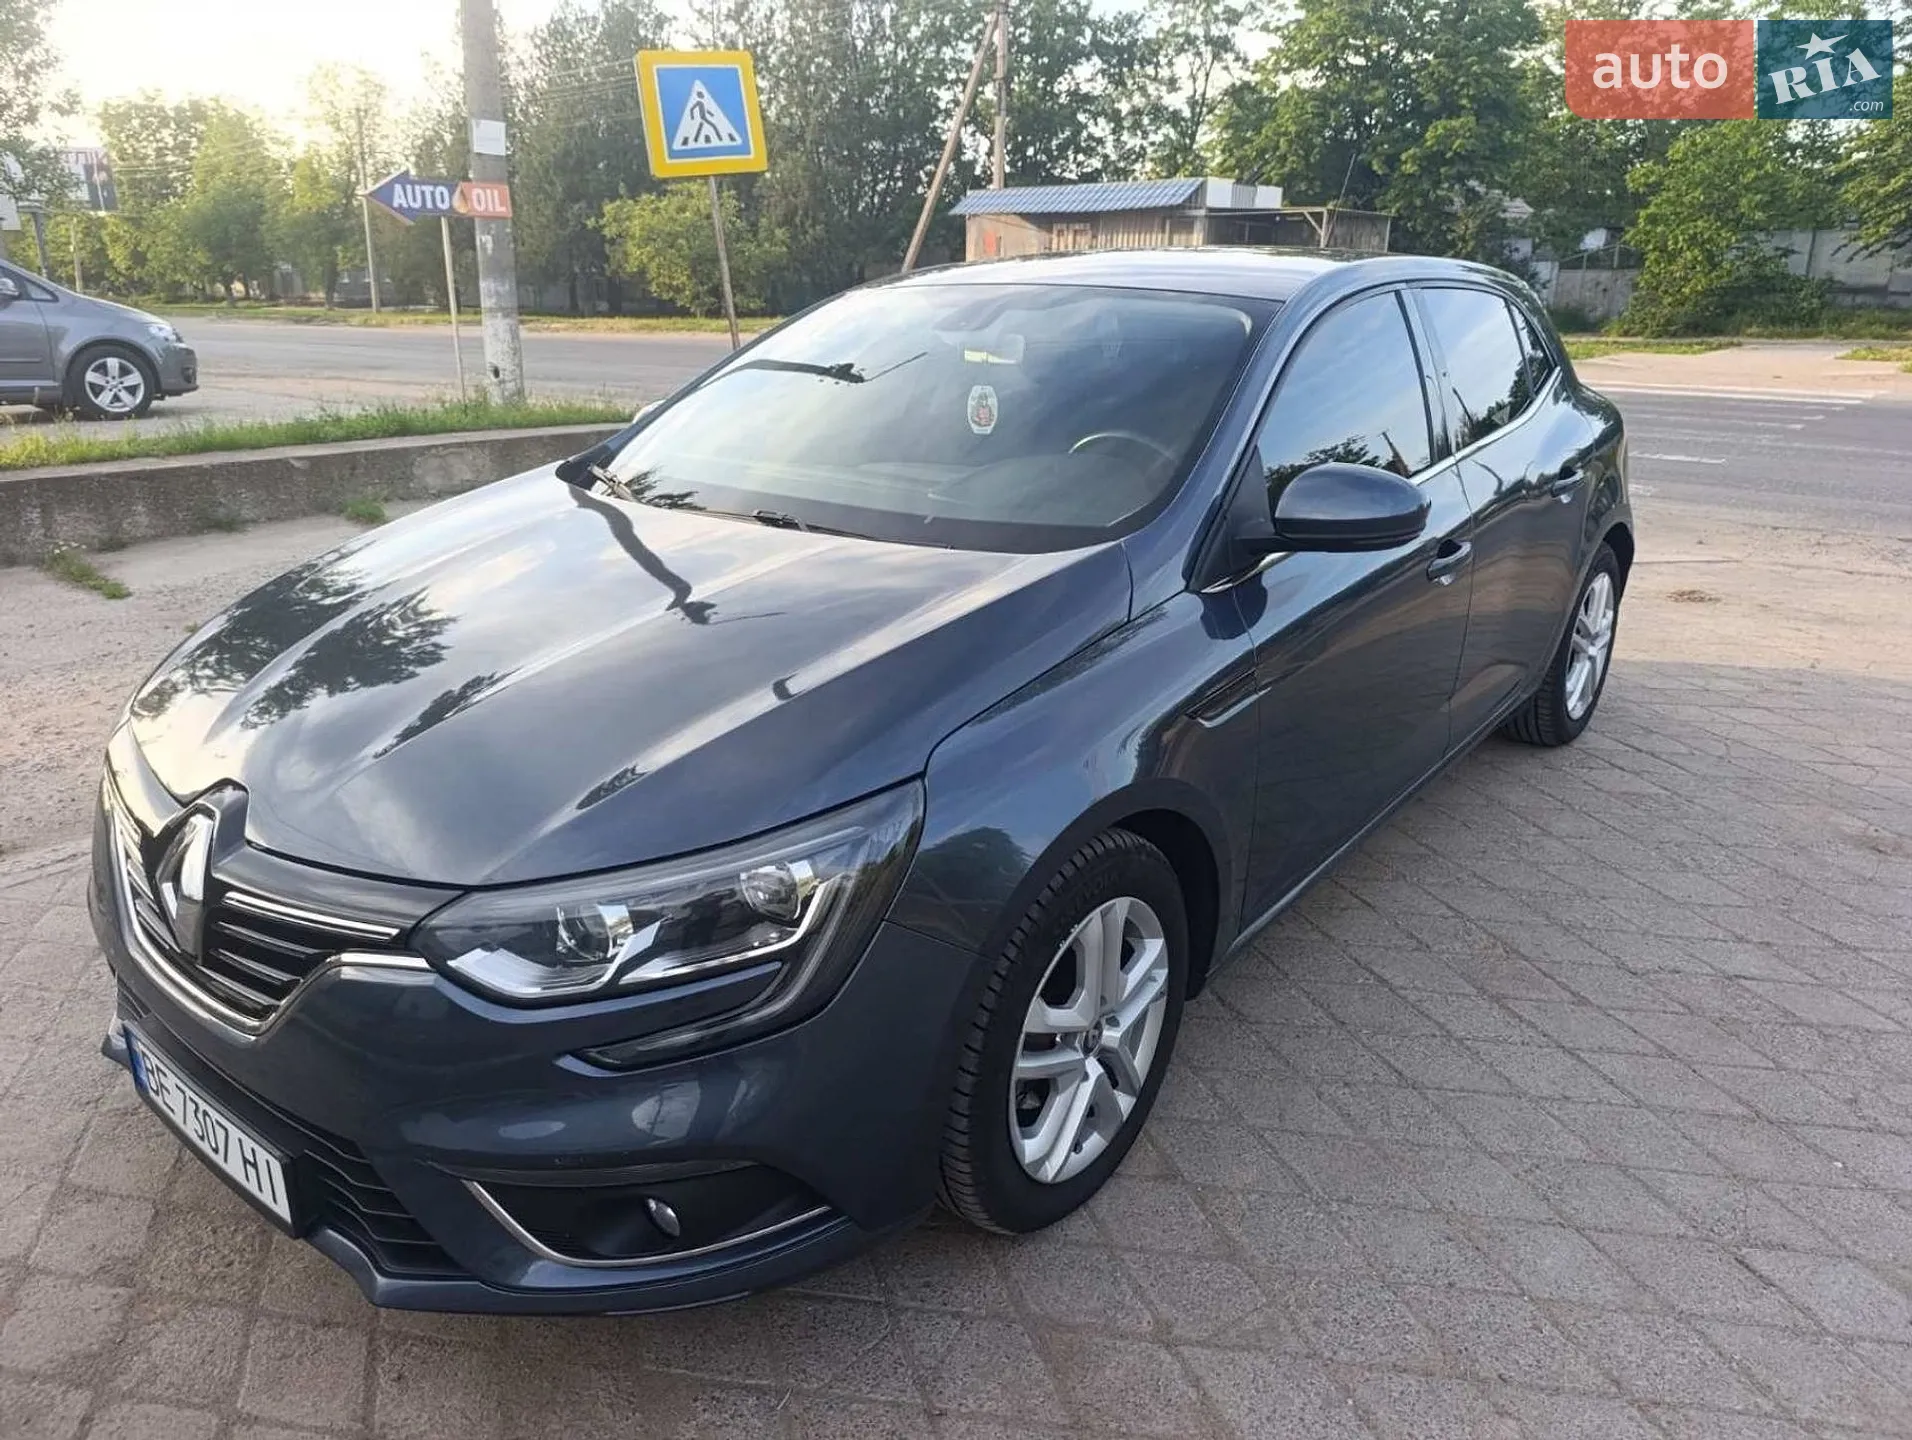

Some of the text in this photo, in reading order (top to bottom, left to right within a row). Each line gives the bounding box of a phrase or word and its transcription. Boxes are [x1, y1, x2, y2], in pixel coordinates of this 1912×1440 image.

[392, 183, 507, 213] AUTO OIL
[141, 1051, 278, 1205] BE 7307 HI
